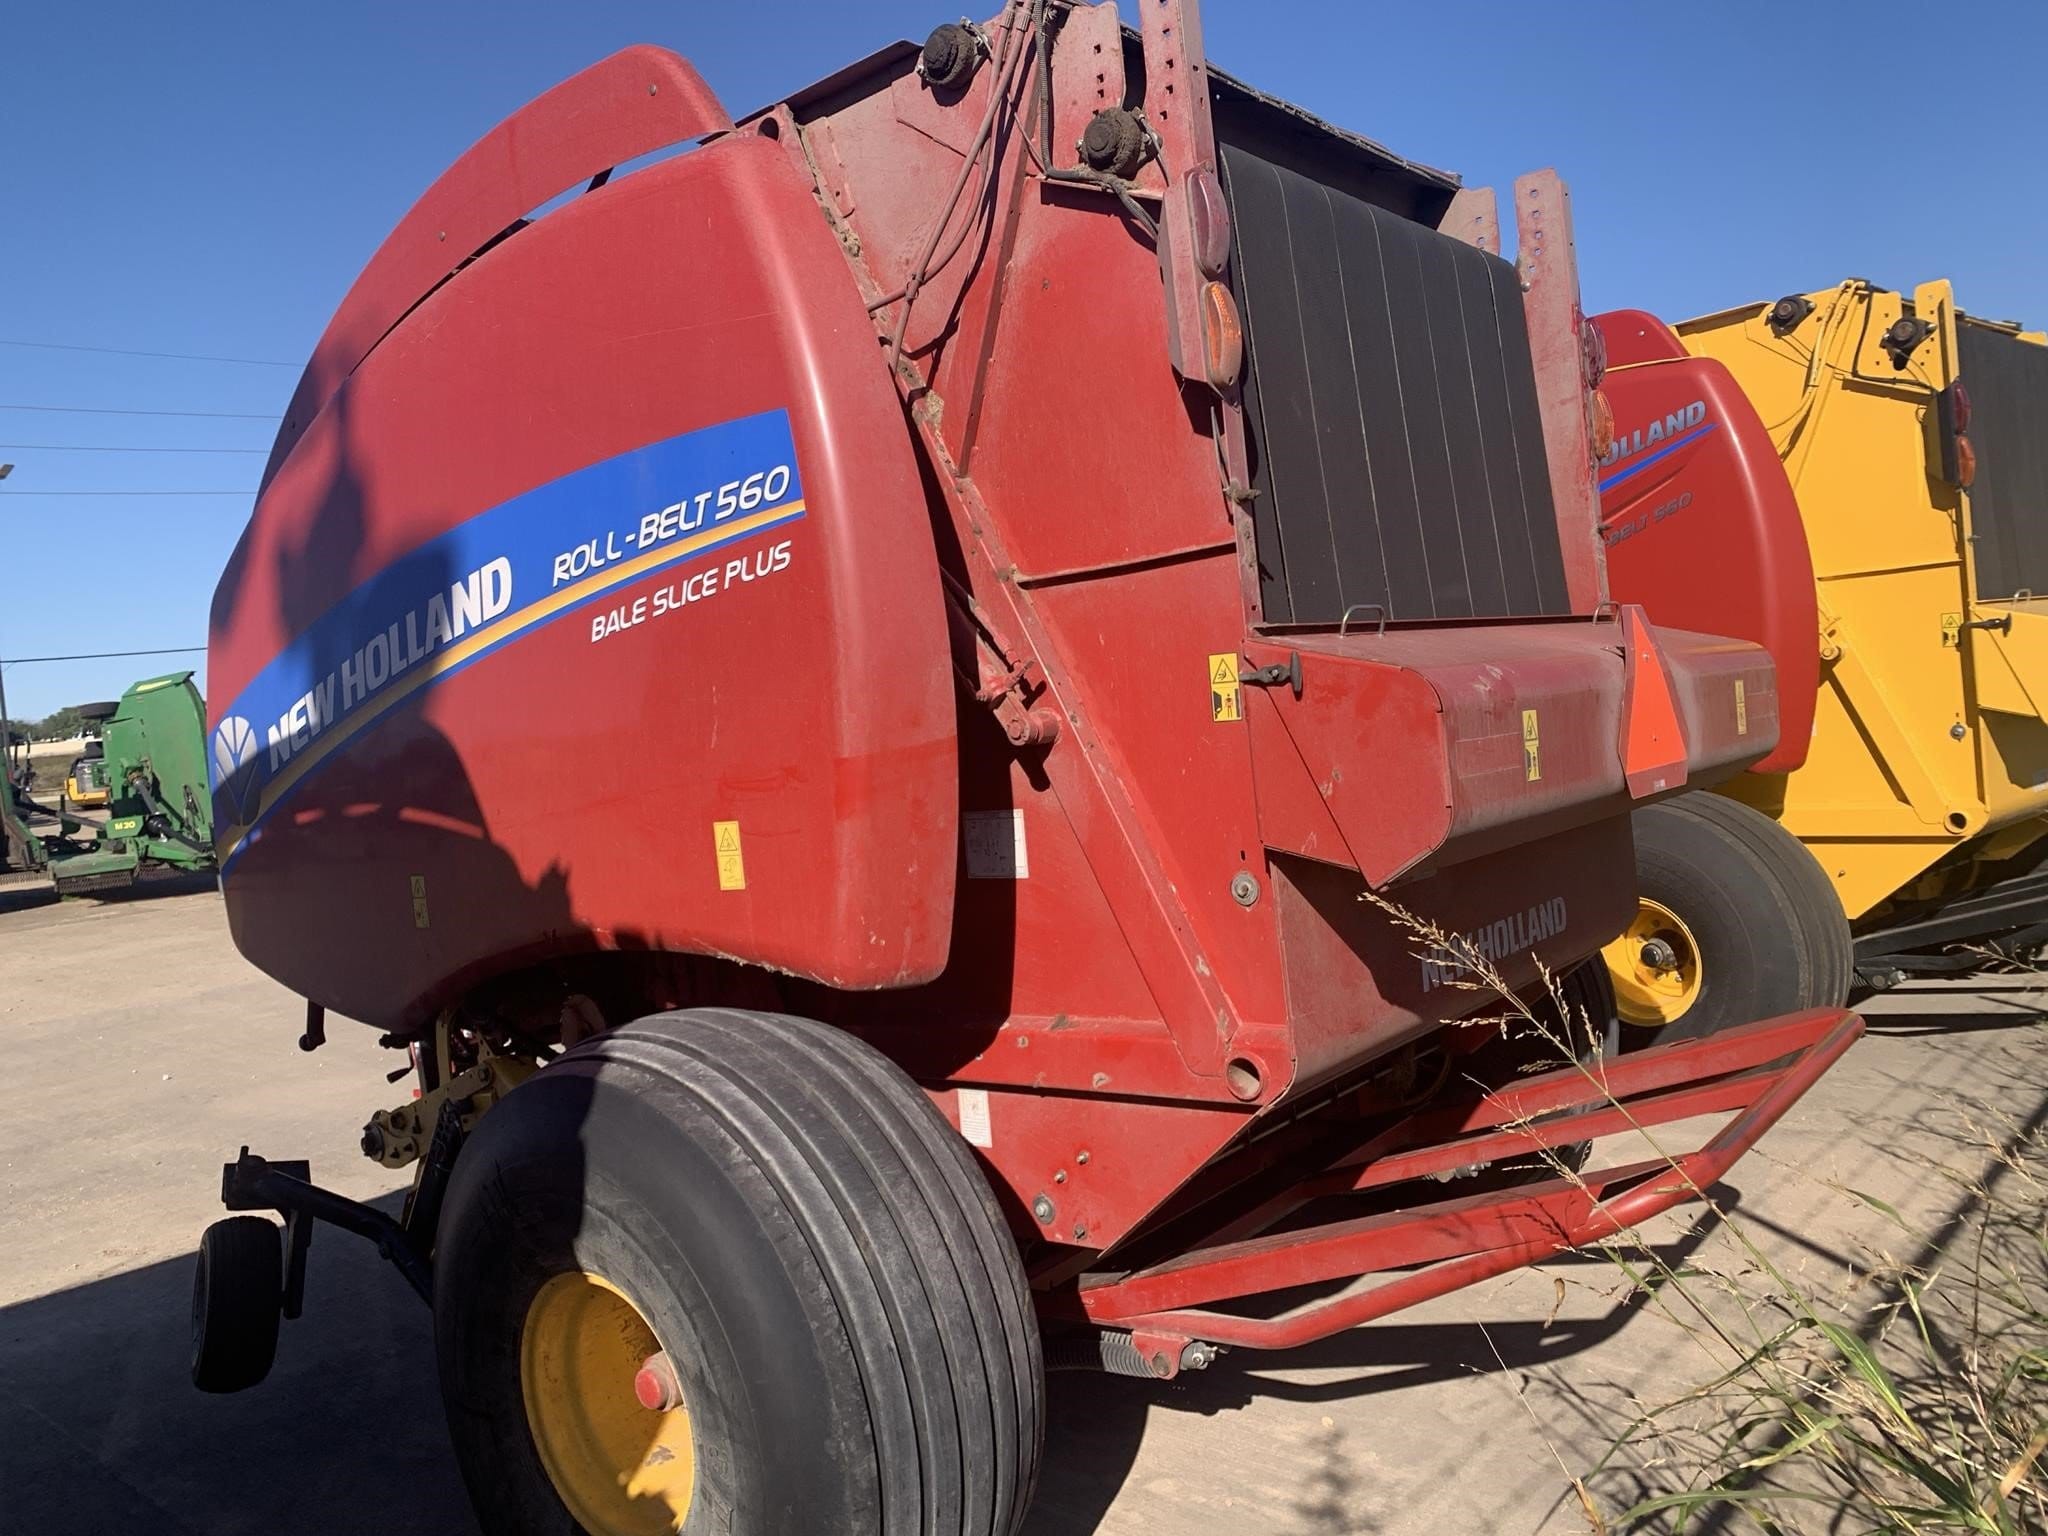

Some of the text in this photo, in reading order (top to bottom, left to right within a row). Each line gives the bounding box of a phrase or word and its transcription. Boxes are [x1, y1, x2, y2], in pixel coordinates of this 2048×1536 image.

[715, 464, 791, 520] 560
[1653, 491, 1693, 522] 560
[591, 540, 792, 642] BALE SLICE PLUS
[267, 556, 513, 773] NEW HOLLAND
[1478, 896, 1567, 962] HOLLAND
